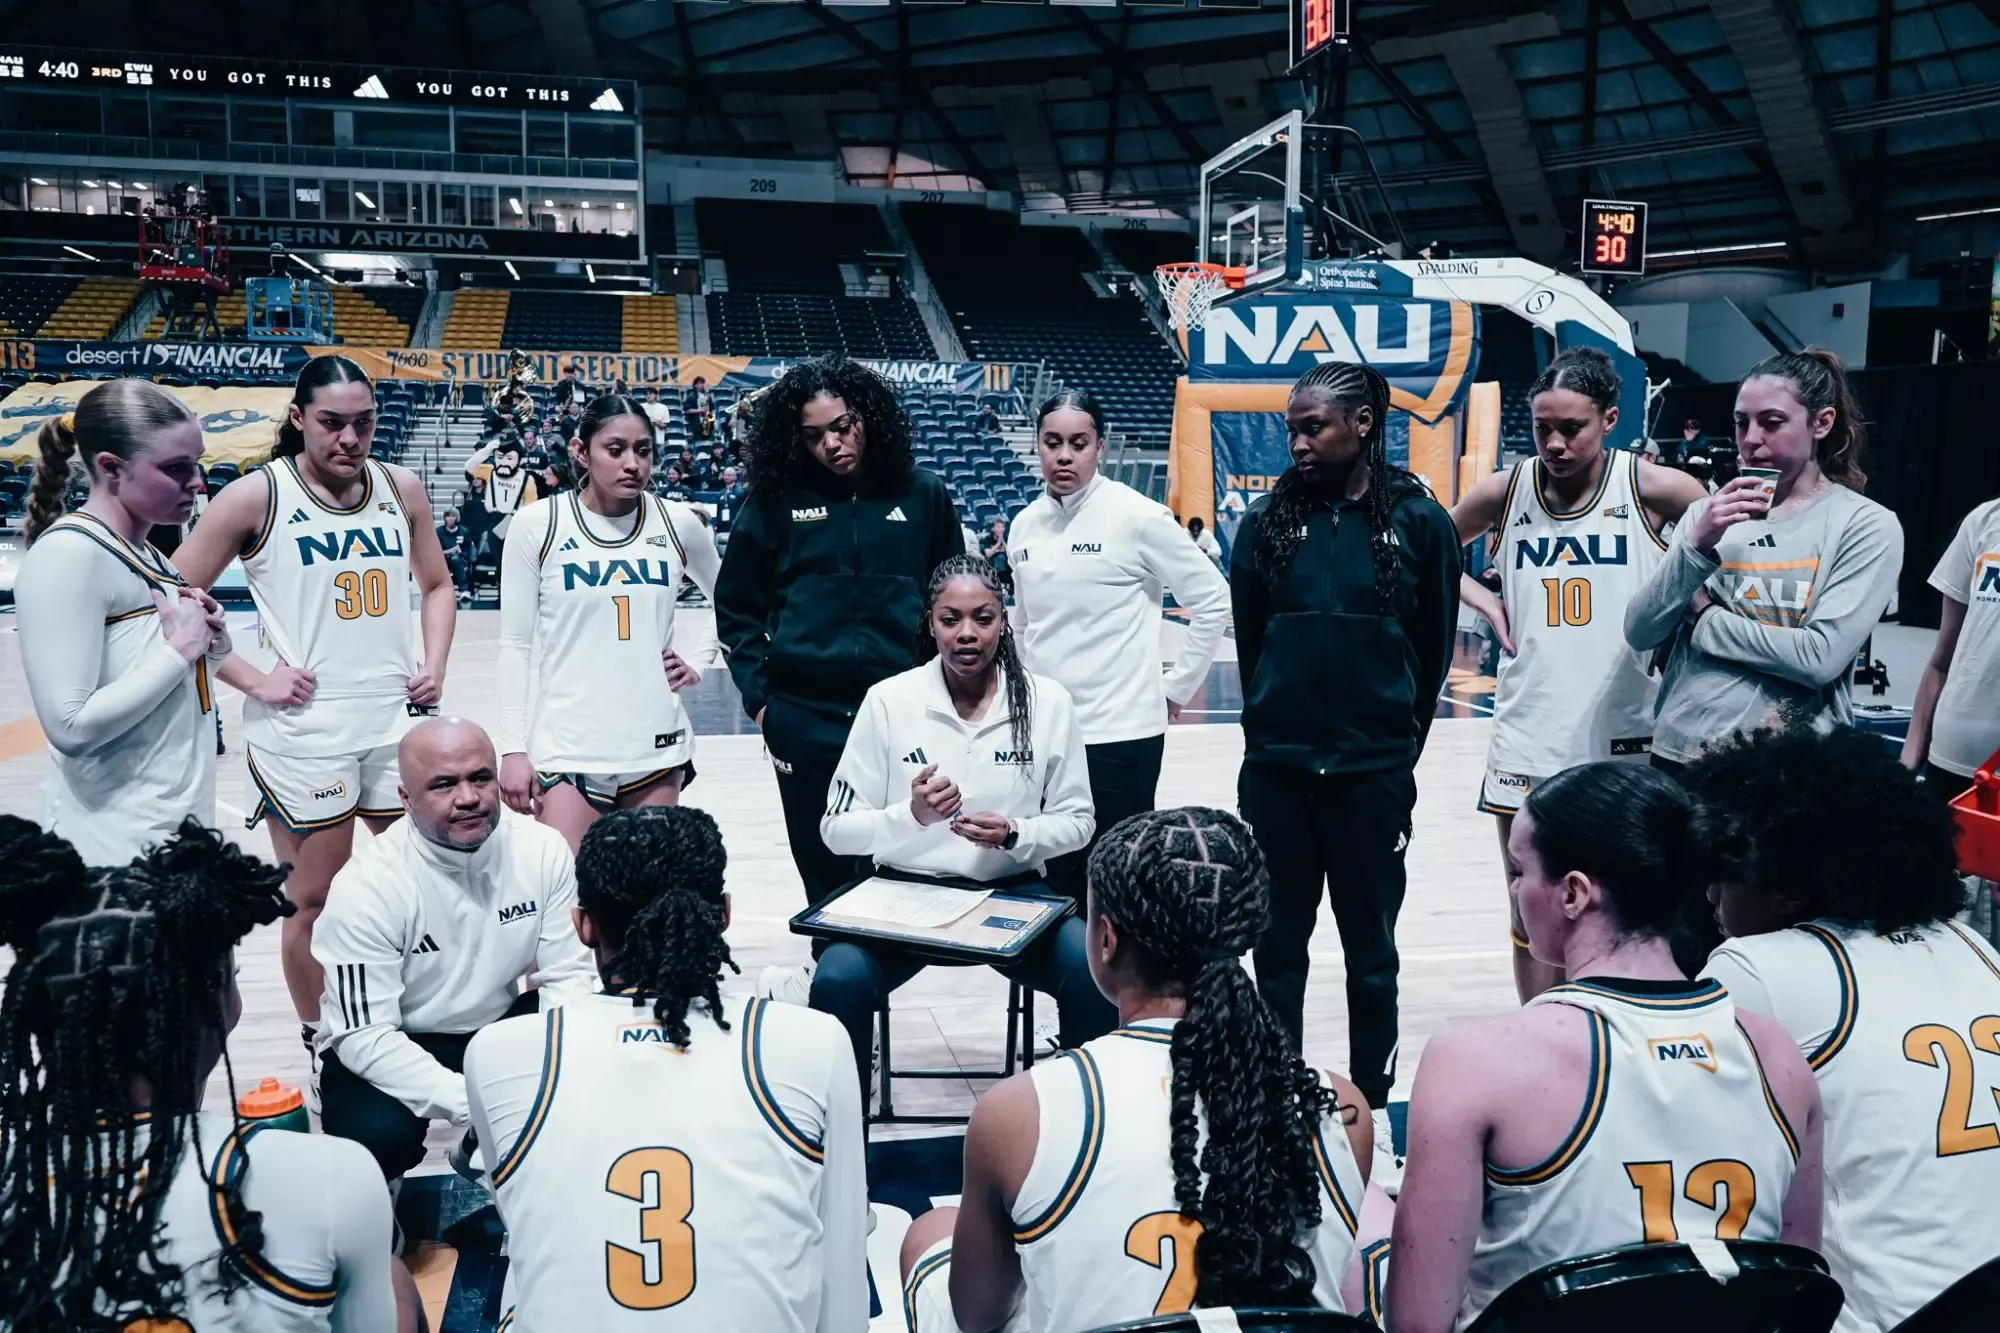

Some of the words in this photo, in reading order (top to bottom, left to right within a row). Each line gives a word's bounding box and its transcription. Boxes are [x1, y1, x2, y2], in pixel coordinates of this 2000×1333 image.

[38, 60, 79, 79] 4:40
[91, 67, 122, 78] 3RD
[124, 63, 153, 72] EWU
[169, 68, 207, 82] YOU
[228, 72, 266, 85] GOT
[286, 75, 332, 89] THIS
[416, 82, 452, 96] YOU
[471, 85, 508, 99] GOT
[526, 88, 570, 102] THIS
[750, 179, 777, 193] 209
[920, 191, 945, 203] 207
[1598, 213, 1635, 234] 4:40
[350, 229, 490, 250] ARIZONA
[1595, 235, 1626, 263] 30
[1320, 266, 1368, 279] Orthopedic
[1368, 268, 1377, 279] &
[1417, 262, 1479, 277] SPALDING
[1320, 277, 1345, 290] Spine
[1203, 303, 1432, 365] NAU
[66, 344, 140, 365] desert
[163, 344, 285, 368] FINANCIAL
[386, 350, 428, 376] 7000
[441, 353, 560, 380] STUDNT
[574, 355, 679, 383] SECTION
[188, 367, 234, 375] CREDIT
[792, 506, 828, 519] NAU
[294, 526, 404, 567] NAU
[1071, 543, 1102, 553] NAU
[1515, 533, 1628, 570] NAU
[561, 558, 670, 591] NAU
[334, 568, 388, 620] 30
[1541, 577, 1592, 627] 10
[611, 595, 631, 641] 1
[995, 750, 1034, 762] NAU
[314, 786, 343, 800] NAU
[1500, 778, 1526, 787] NAU
[498, 900, 538, 922] NAU
[1657, 1043, 1709, 1060] NAU
[1623, 1158, 1756, 1242] 12
[606, 1147, 696, 1311] 3
